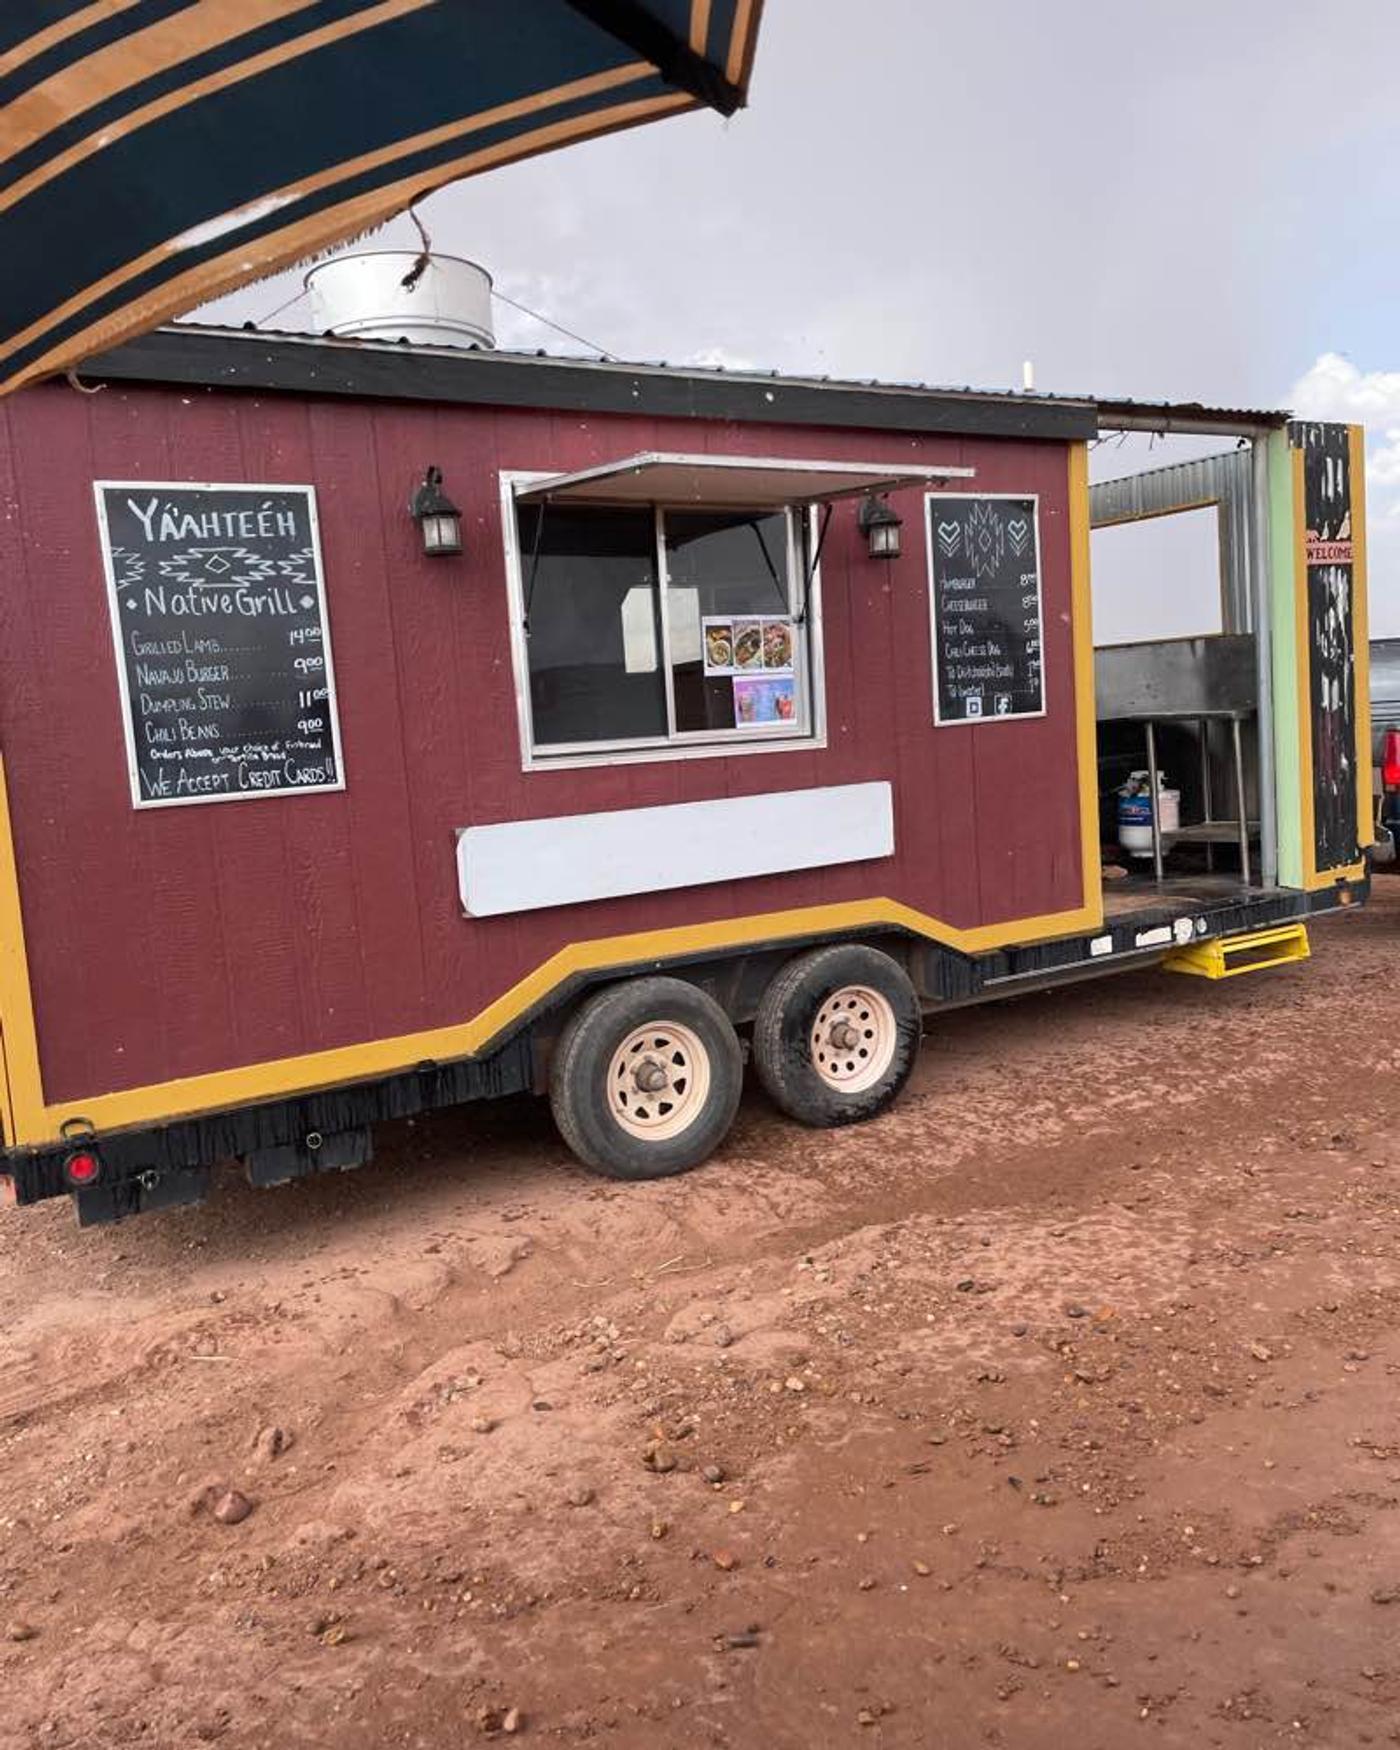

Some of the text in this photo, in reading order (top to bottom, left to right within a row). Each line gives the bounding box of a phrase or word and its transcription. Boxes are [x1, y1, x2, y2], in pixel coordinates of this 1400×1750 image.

[1306, 546, 1353, 560] WELCOME
[136, 663, 185, 687] NAVAJO
[185, 659, 230, 682] BURGER
[197, 687, 230, 711] STEW
[145, 721, 176, 744] CHILI
[178, 717, 220, 740] BEANS
[141, 767, 172, 797] WE
[177, 767, 230, 794] ACCEPT
[238, 761, 281, 790] CREDIT
